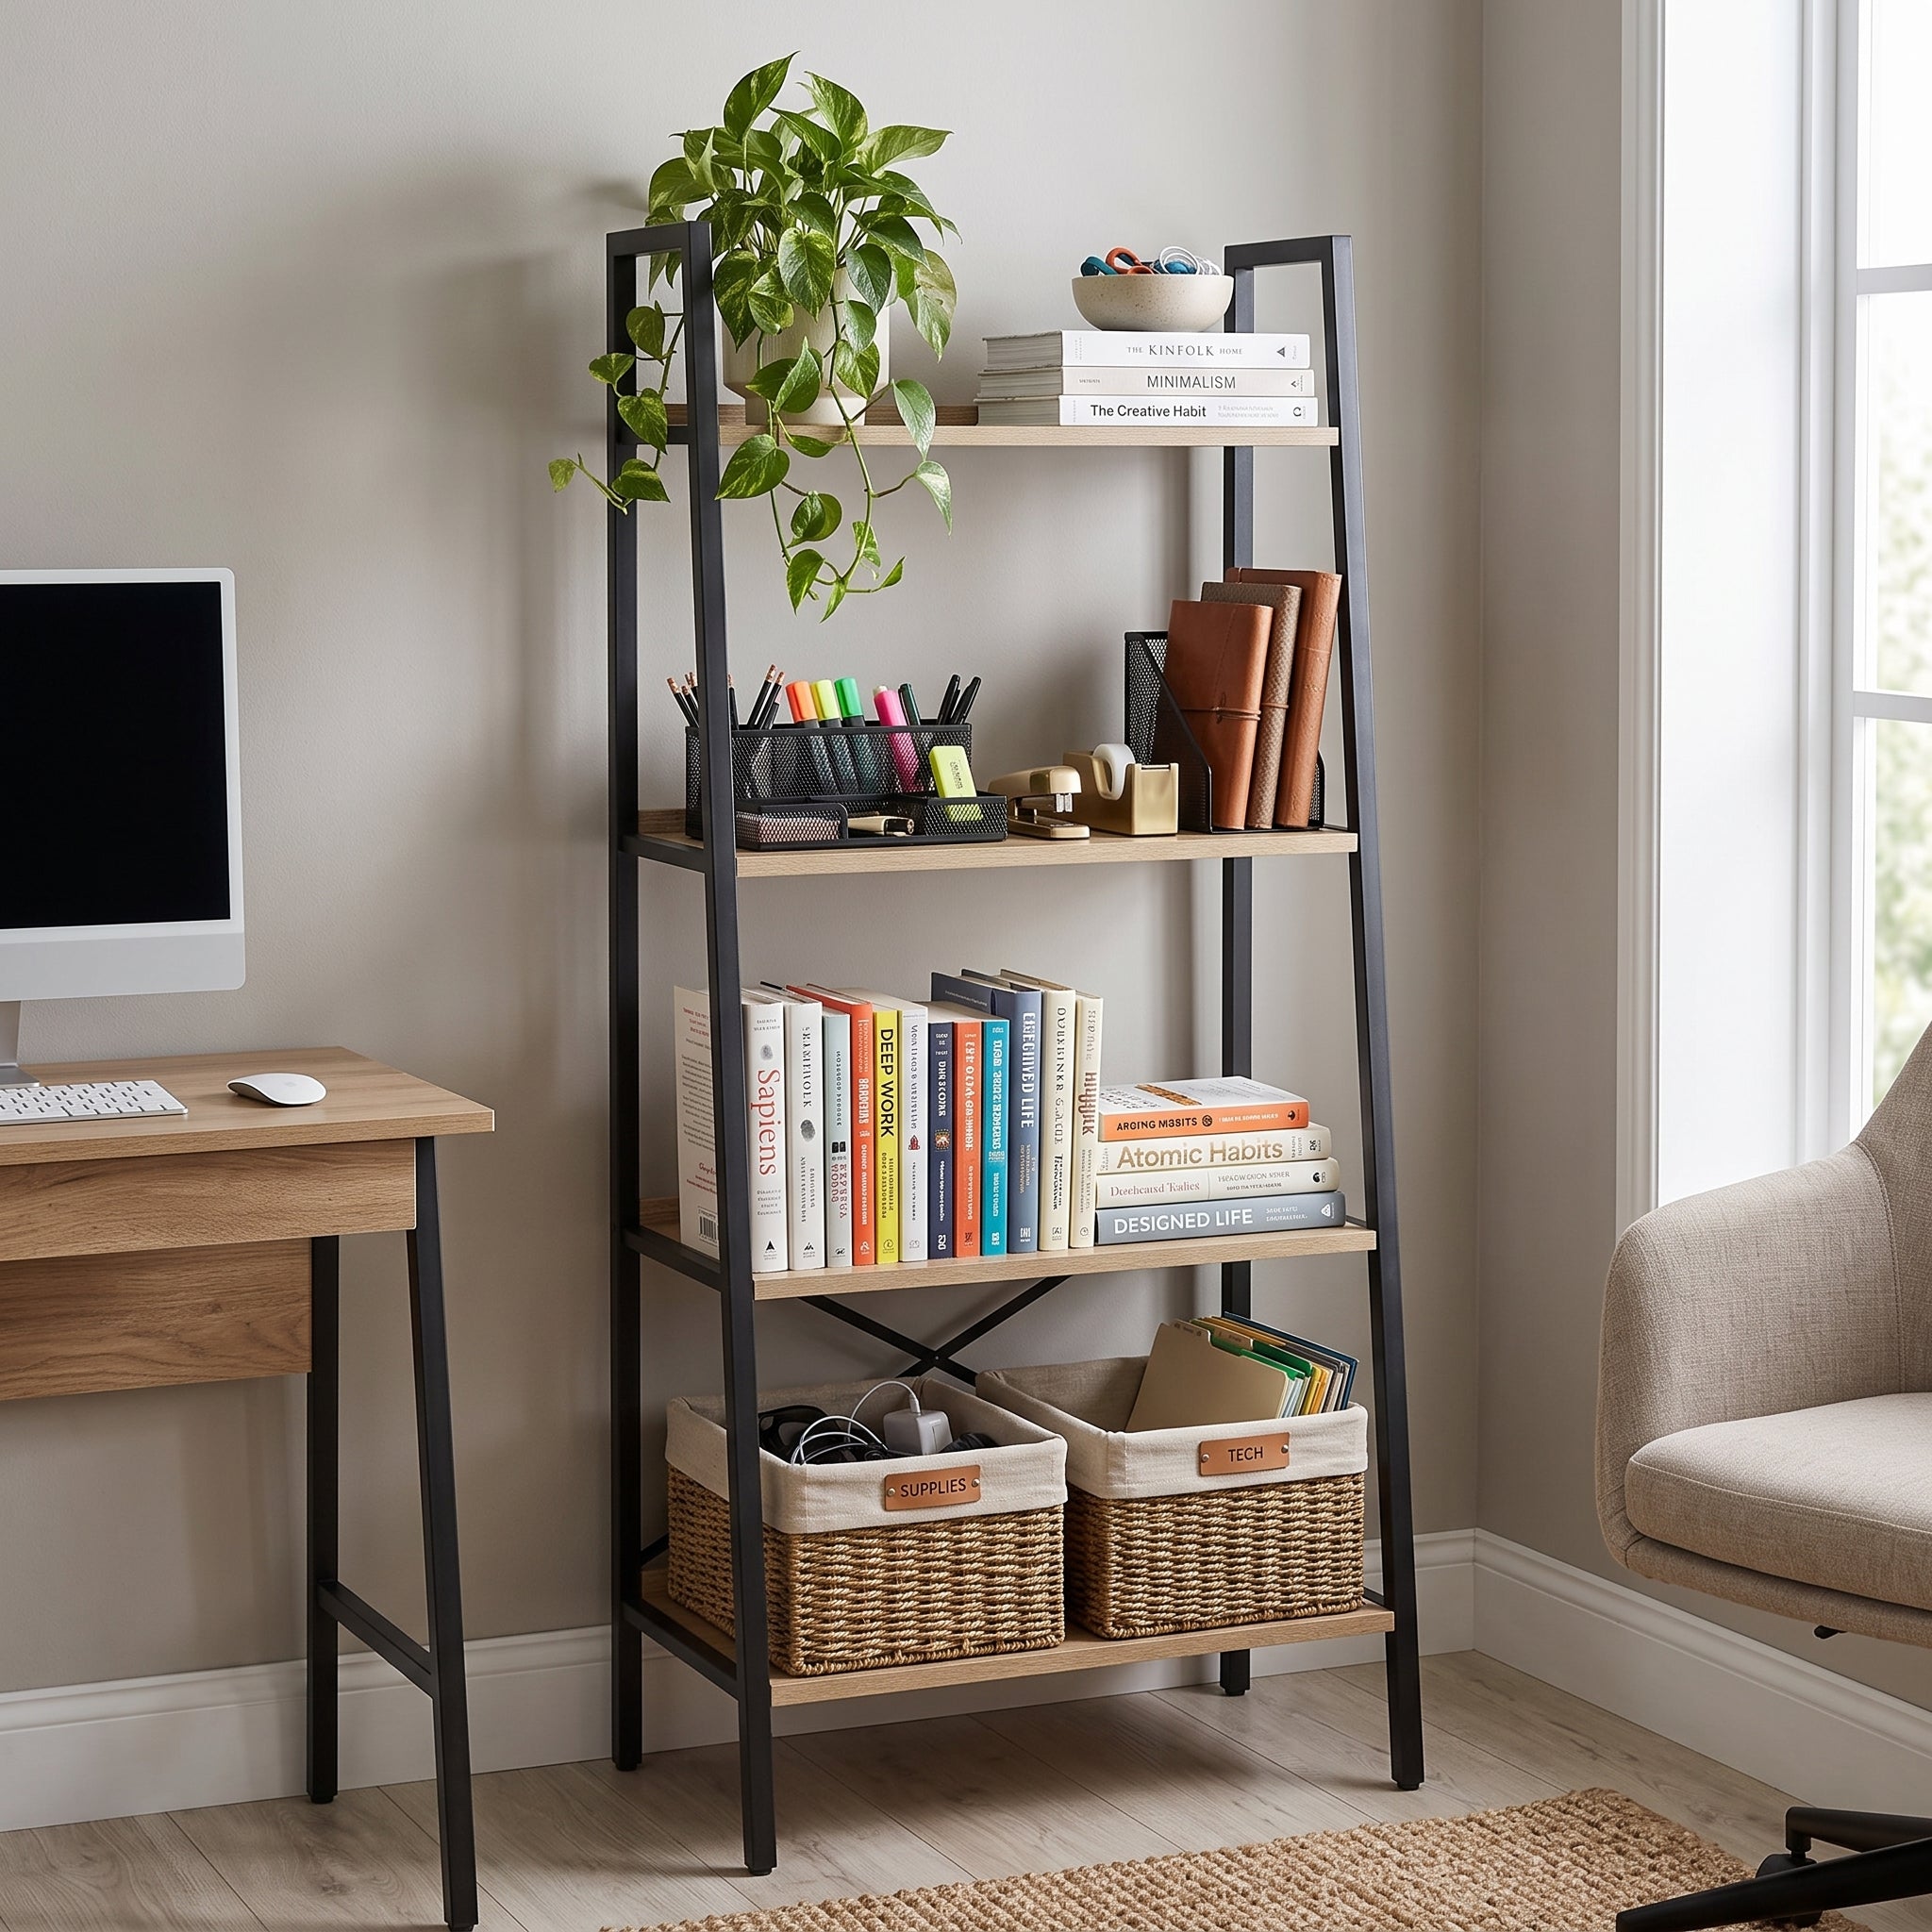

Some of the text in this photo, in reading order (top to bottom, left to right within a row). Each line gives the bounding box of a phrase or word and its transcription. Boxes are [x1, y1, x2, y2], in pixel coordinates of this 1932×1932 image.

[1148, 344, 1214, 357] KINFOLK
[1147, 375, 1236, 389] MINIMALISM
[1091, 405, 1114, 417] The
[1117, 405, 1170, 417] Creative
[1174, 405, 1207, 417] Habit
[880, 1028, 894, 1075] DEEP
[750, 1069, 781, 1176] Sapiens
[880, 1080, 894, 1138] WORK
[1021, 1098, 1035, 1128] LIFE
[1116, 1141, 1203, 1169] Atomic
[1208, 1138, 1283, 1163] Habits
[1114, 1212, 1210, 1235] DESIGNED
[1216, 1208, 1253, 1227] LIFE
[1227, 1446, 1263, 1462] TECH
[900, 1477, 967, 1498] SUPPLIES
